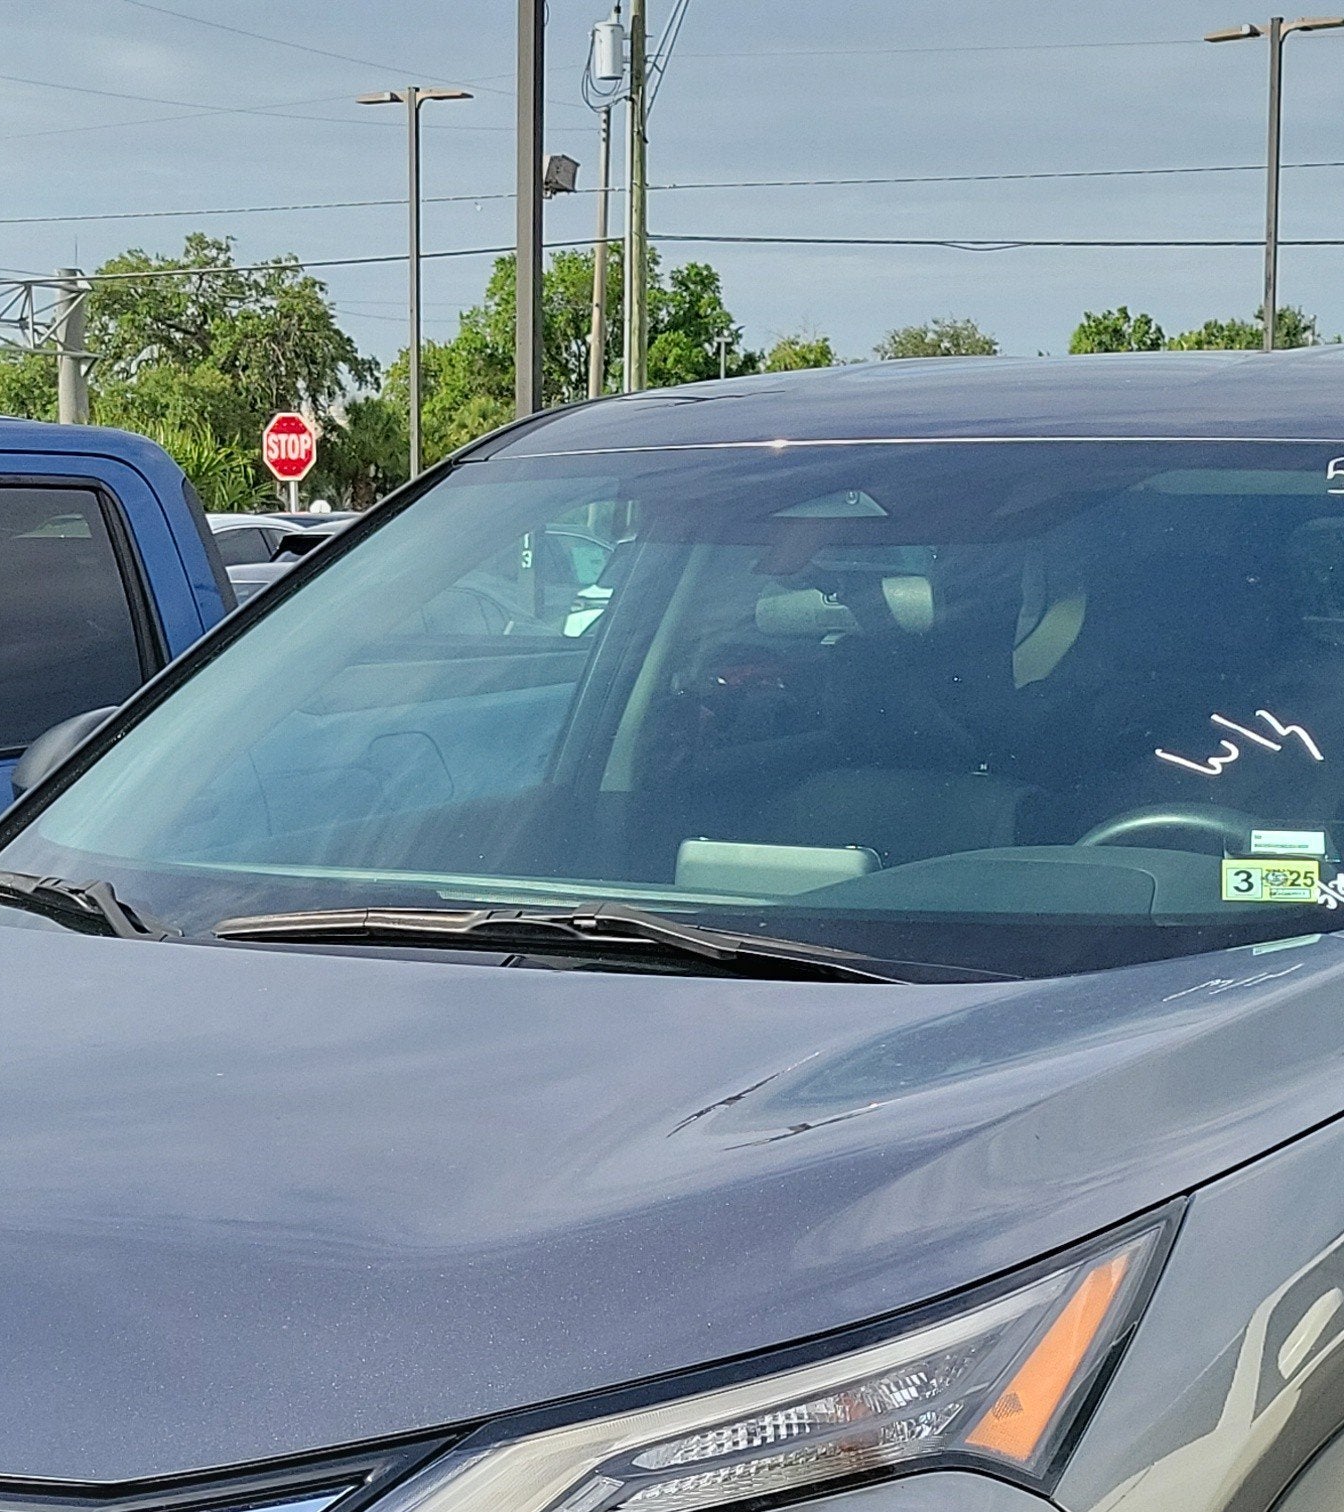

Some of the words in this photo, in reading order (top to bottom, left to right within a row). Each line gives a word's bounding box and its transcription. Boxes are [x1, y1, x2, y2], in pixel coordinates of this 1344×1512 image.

[267, 433, 312, 460] STOP
[1233, 869, 1255, 893] 3
[1289, 870, 1316, 888] 25
